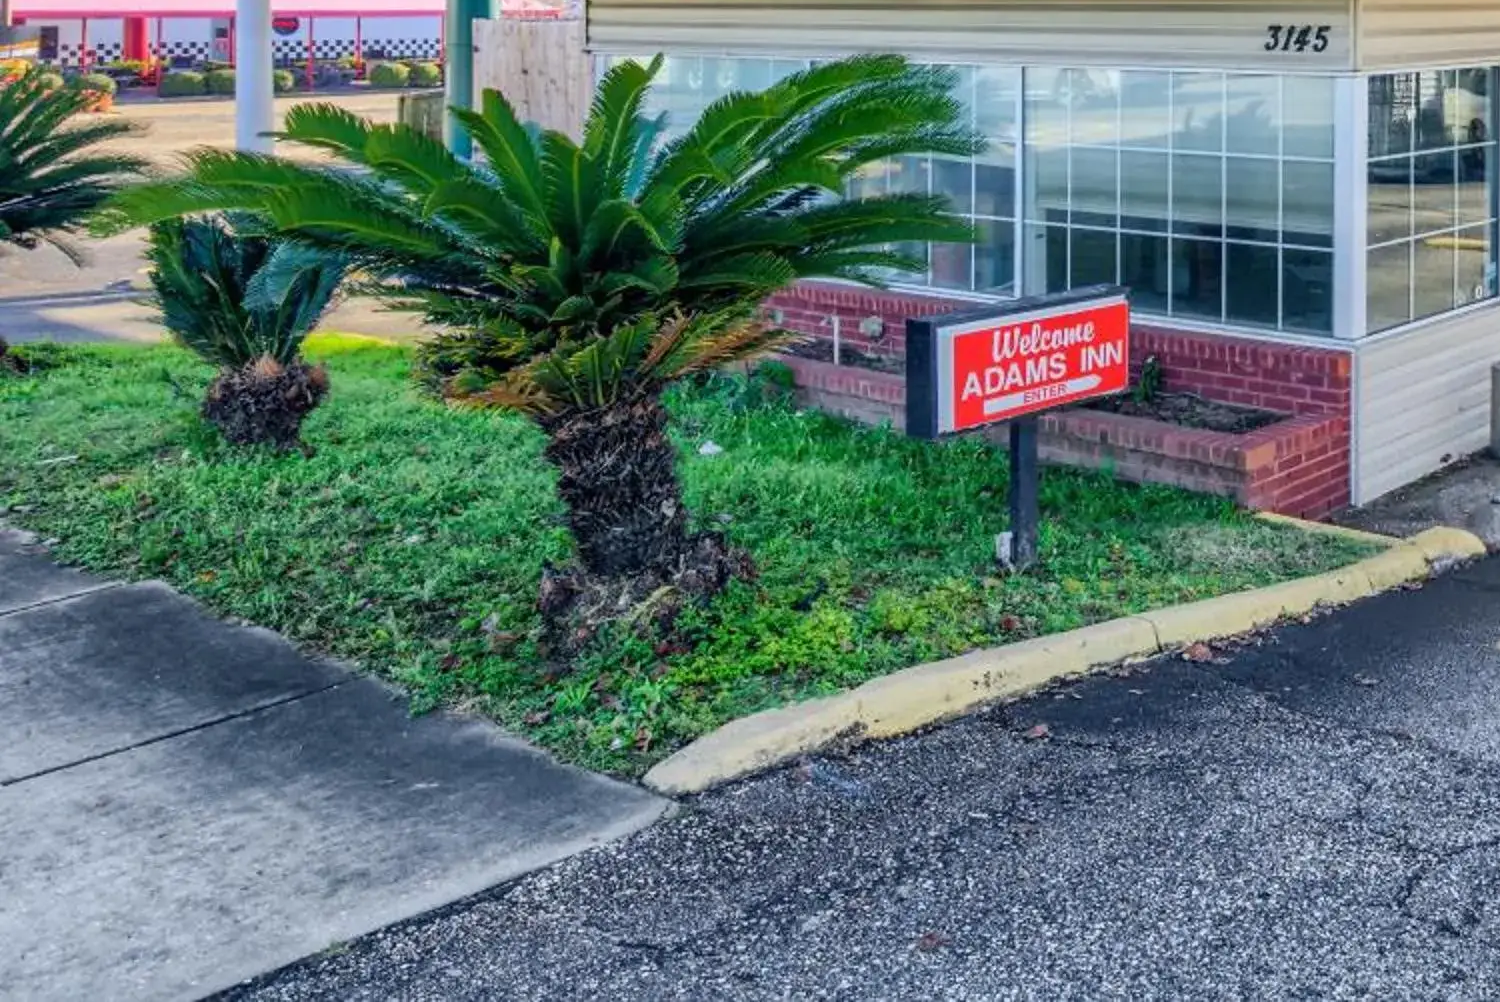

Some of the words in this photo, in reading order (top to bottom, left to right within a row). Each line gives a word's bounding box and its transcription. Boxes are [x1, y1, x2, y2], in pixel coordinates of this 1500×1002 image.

[1264, 25, 1331, 52] 3145
[992, 321, 1095, 363] Welcome
[961, 352, 1067, 401] ADAMS
[1080, 340, 1123, 373] INN
[1023, 384, 1067, 404] ENTER
